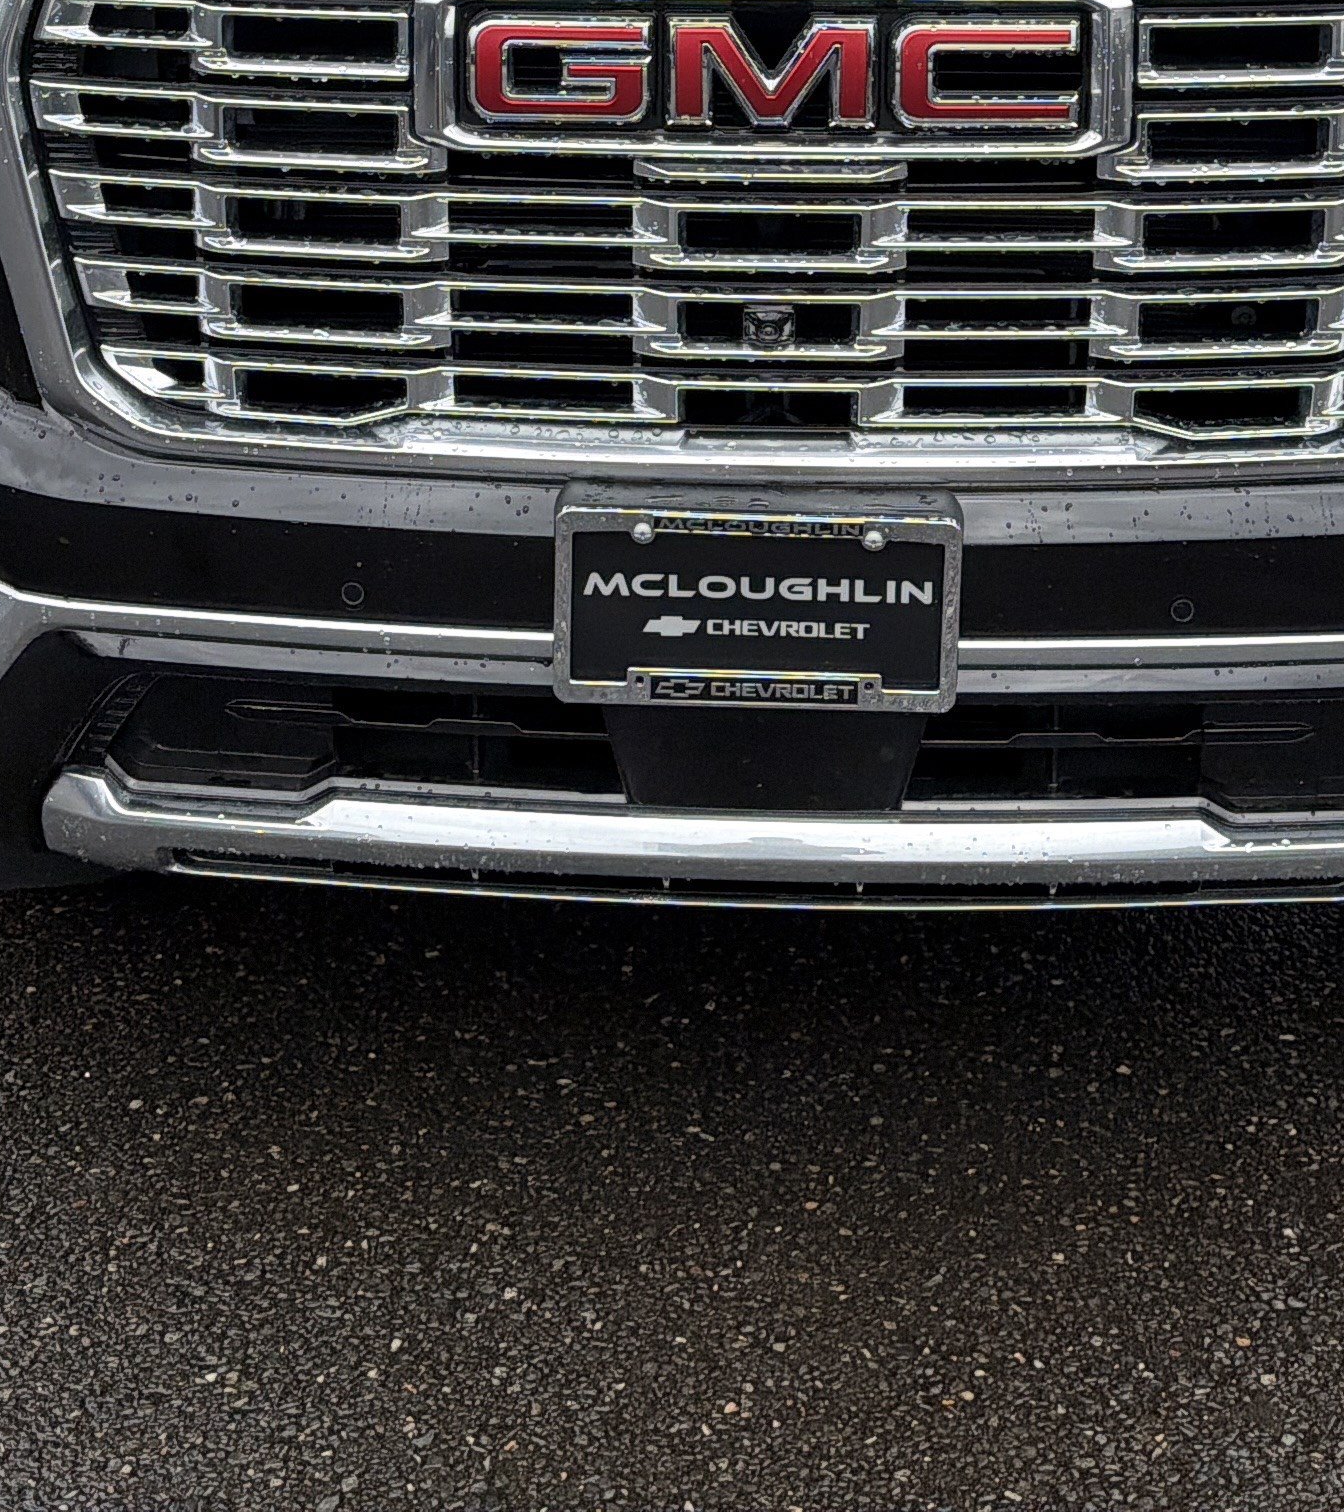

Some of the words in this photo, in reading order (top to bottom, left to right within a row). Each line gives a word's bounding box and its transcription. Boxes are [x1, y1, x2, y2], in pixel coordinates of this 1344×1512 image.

[467, 14, 1082, 132] GMC
[656, 517, 862, 537] MCLOUGHLIN
[583, 571, 934, 605] MCLOUGHLIN
[706, 618, 871, 640] CHEVROLET
[710, 681, 855, 700] CHEVROLET
